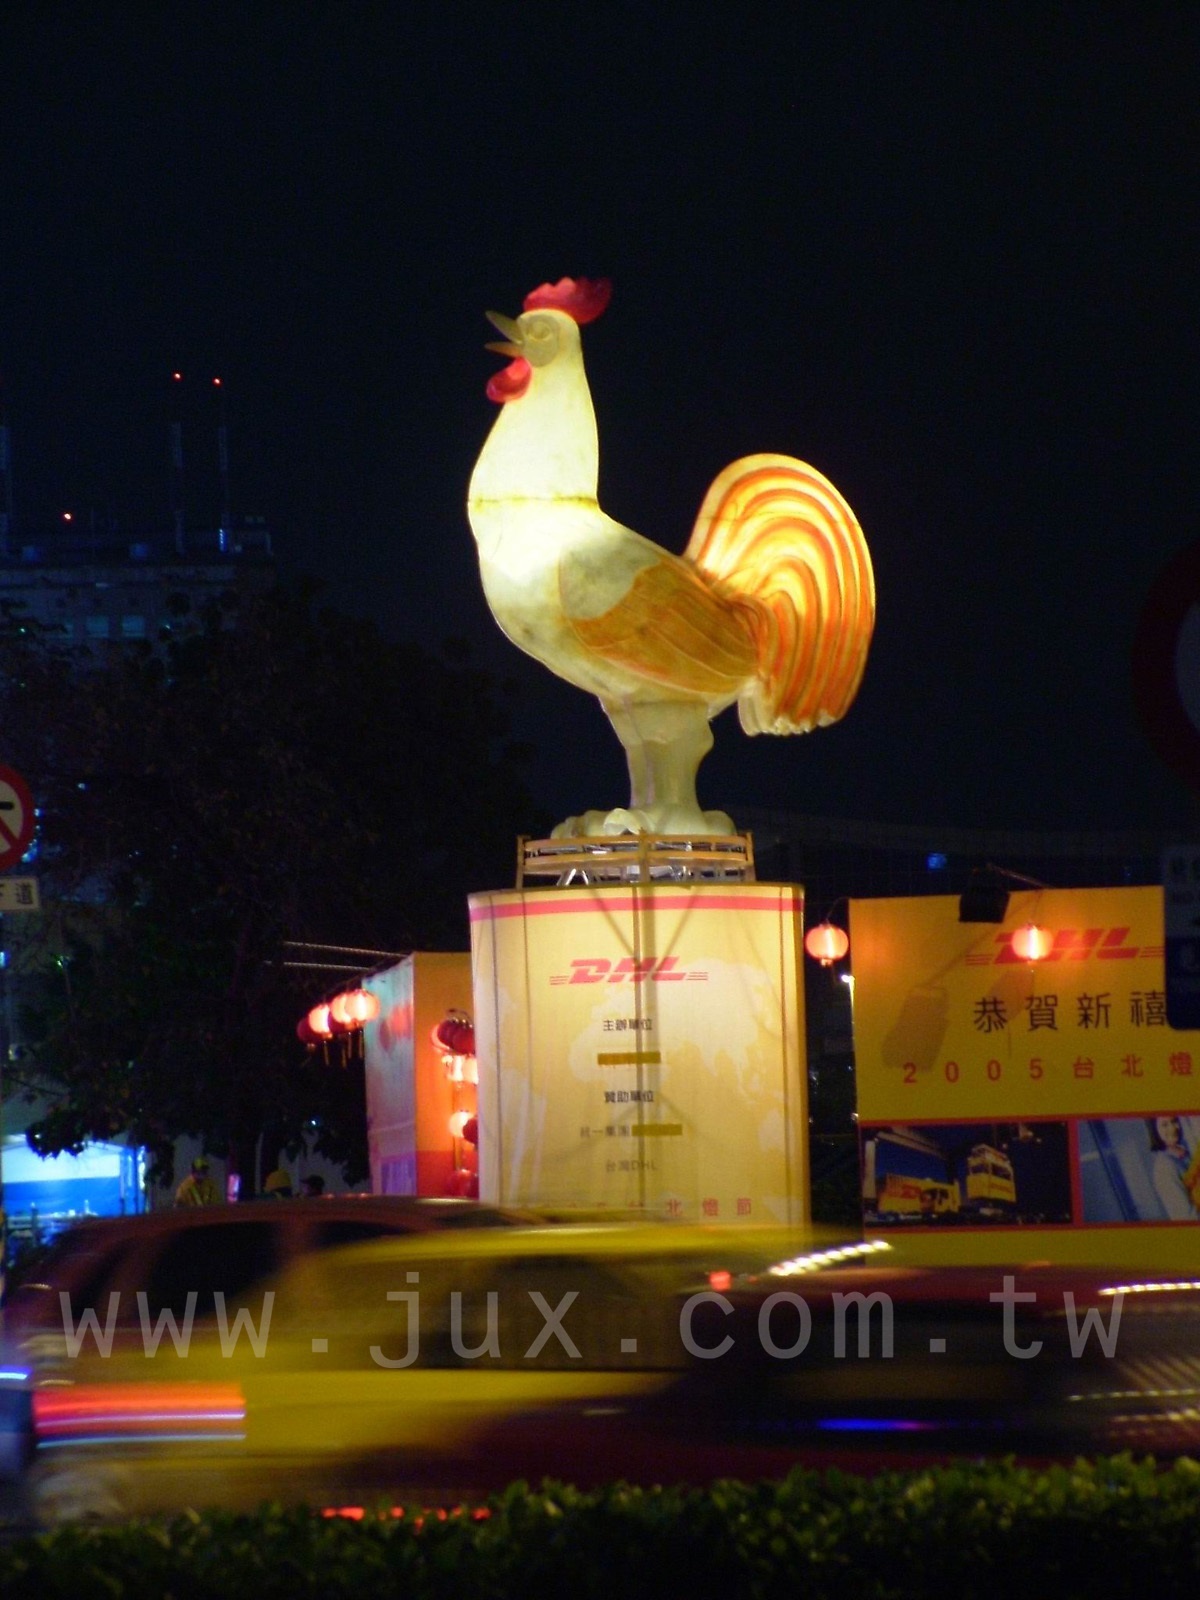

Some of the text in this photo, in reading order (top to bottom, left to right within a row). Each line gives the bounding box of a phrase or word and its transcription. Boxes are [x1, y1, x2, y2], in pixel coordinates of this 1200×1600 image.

[568, 956, 687, 985] DHL
[603, 1018, 653, 1032] 主辦單位
[973, 989, 1168, 1034] 恭賀新禧
